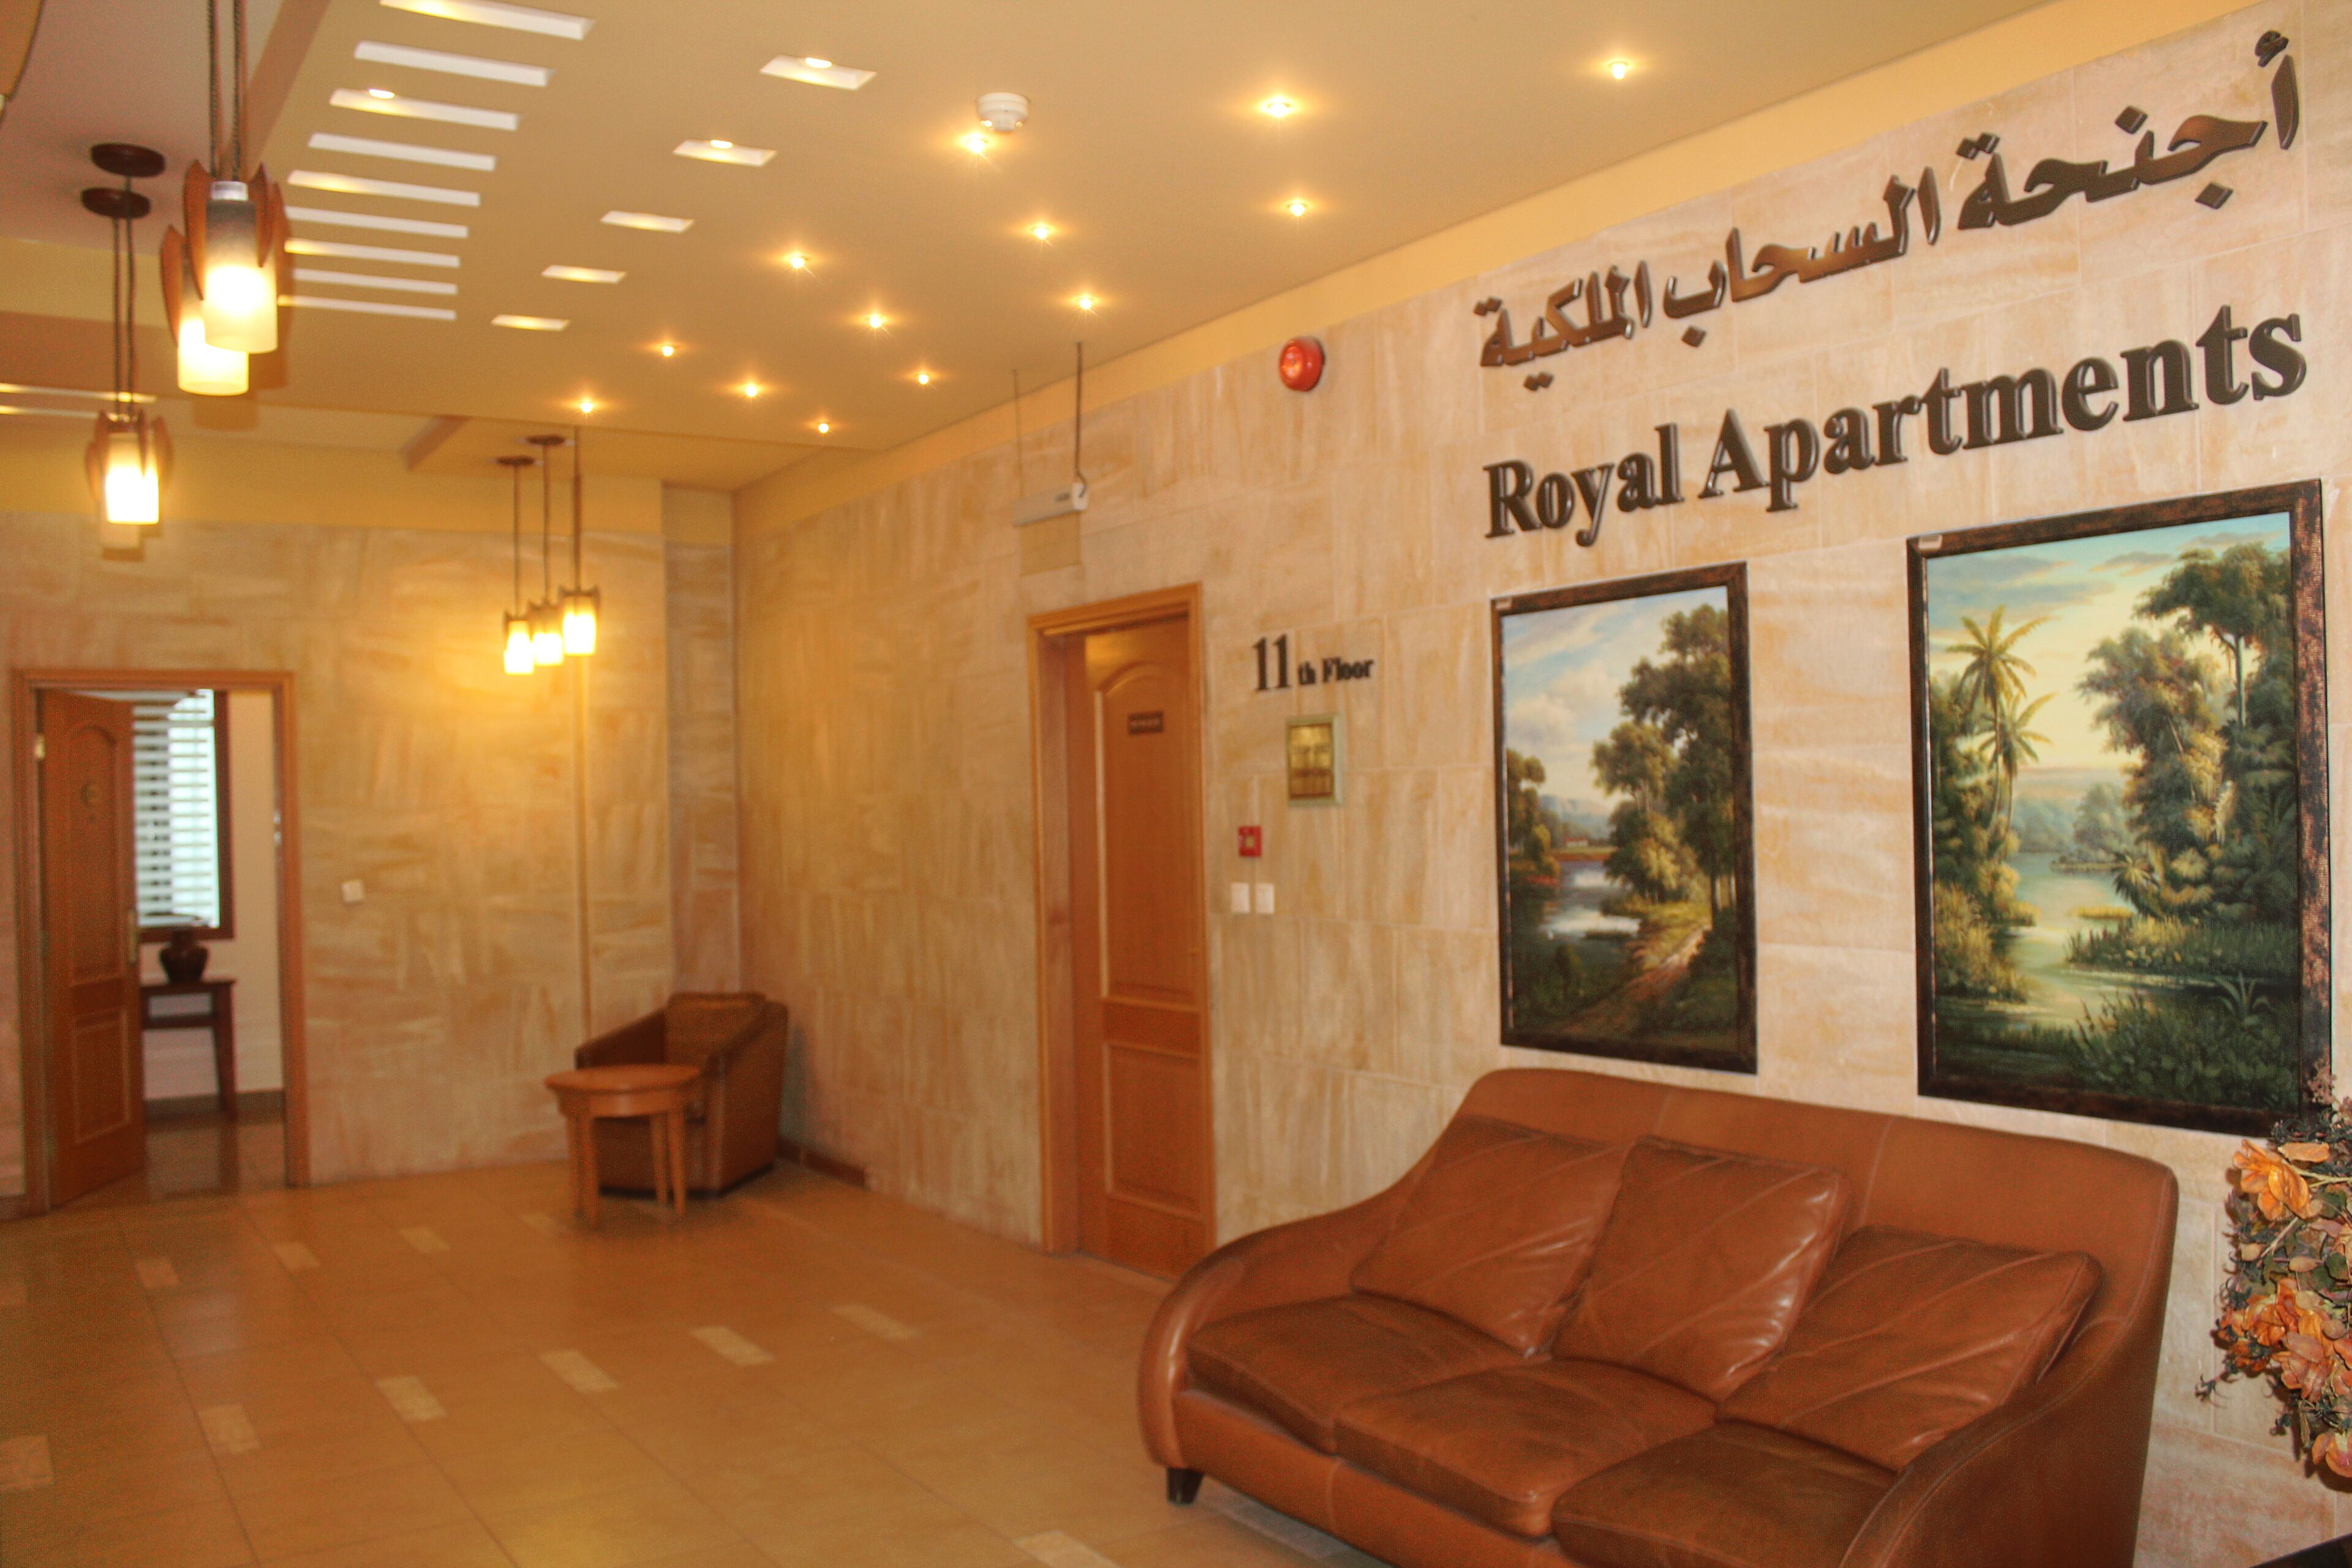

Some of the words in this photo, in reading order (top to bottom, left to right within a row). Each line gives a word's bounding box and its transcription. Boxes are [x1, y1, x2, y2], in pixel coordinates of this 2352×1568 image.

[1956, 29, 2299, 229] أجنحة
[1663, 166, 1941, 347] السحاب
[1485, 423, 1684, 547] Royal
[1698, 305, 2308, 513] Apartments
[1251, 633, 1291, 692] 11
[1322, 657, 1374, 684] Floor
